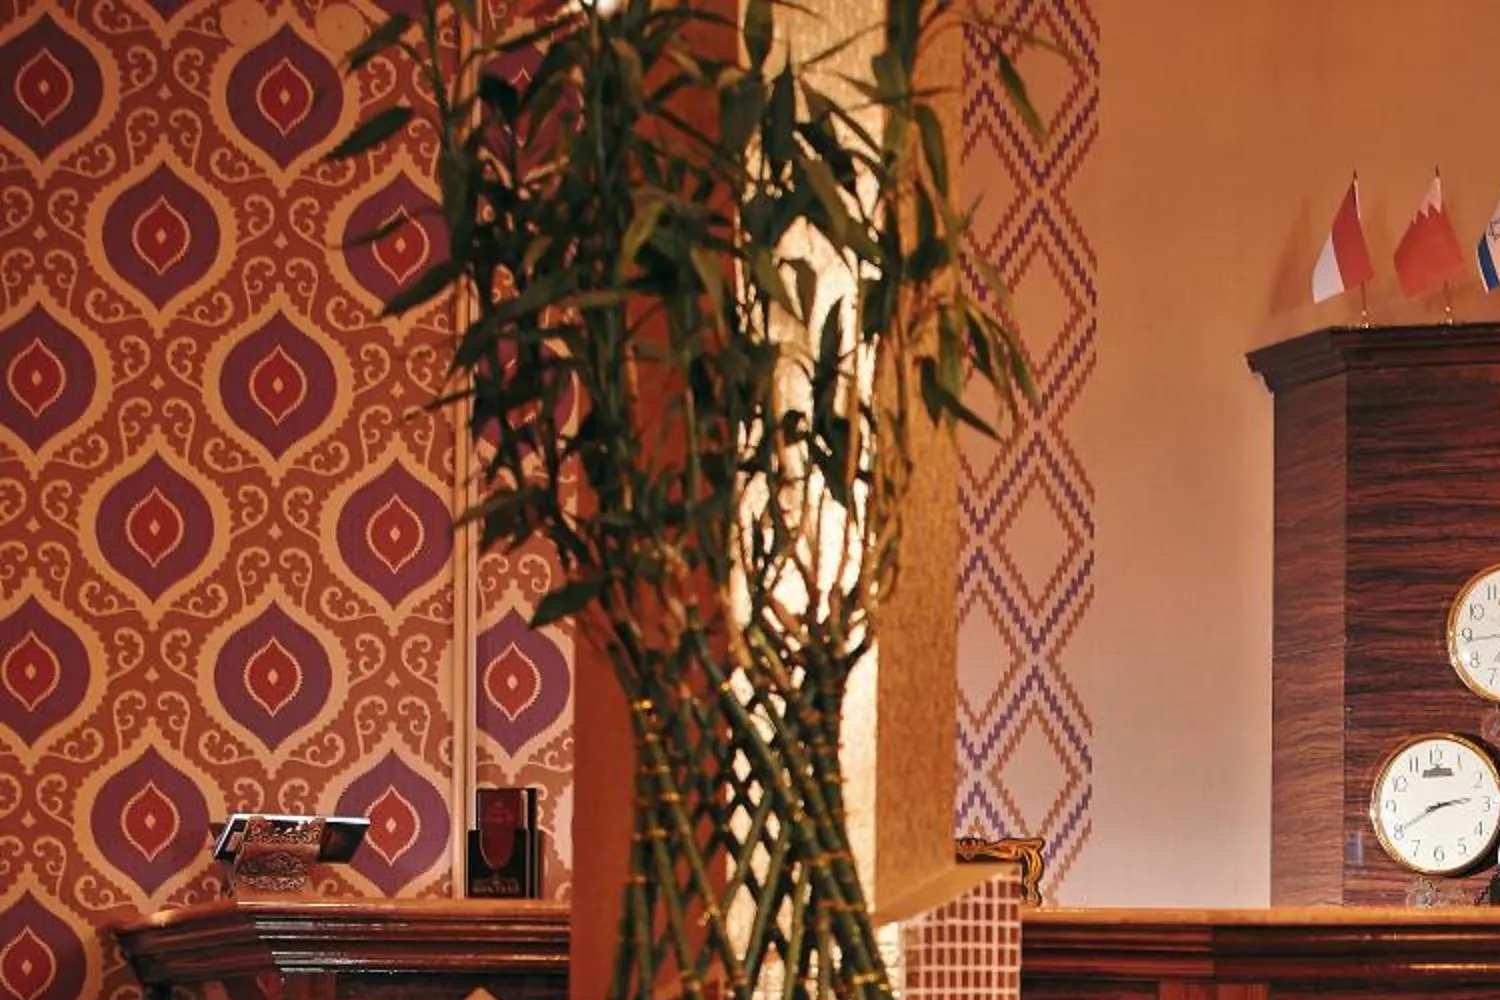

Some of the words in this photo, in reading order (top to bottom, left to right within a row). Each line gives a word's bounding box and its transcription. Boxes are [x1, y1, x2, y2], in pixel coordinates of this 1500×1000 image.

[1487, 584, 1497, 600] 11
[1469, 603, 1484, 620] 10
[1461, 628, 1472, 641] 9
[1469, 651, 1480, 669] 8
[1488, 667, 1498, 686] 7
[1410, 756, 1418, 772] 11
[1429, 749, 1443, 766] 12
[1393, 776, 1408, 792] 10
[1386, 800, 1397, 813] 9
[1483, 796, 1491, 812] 3
[1394, 823, 1404, 840] 8
[1474, 820, 1482, 837] 4
[1411, 840, 1421, 857] 7
[1434, 846, 1444, 861] 6
[1458, 837, 1467, 855] 5
